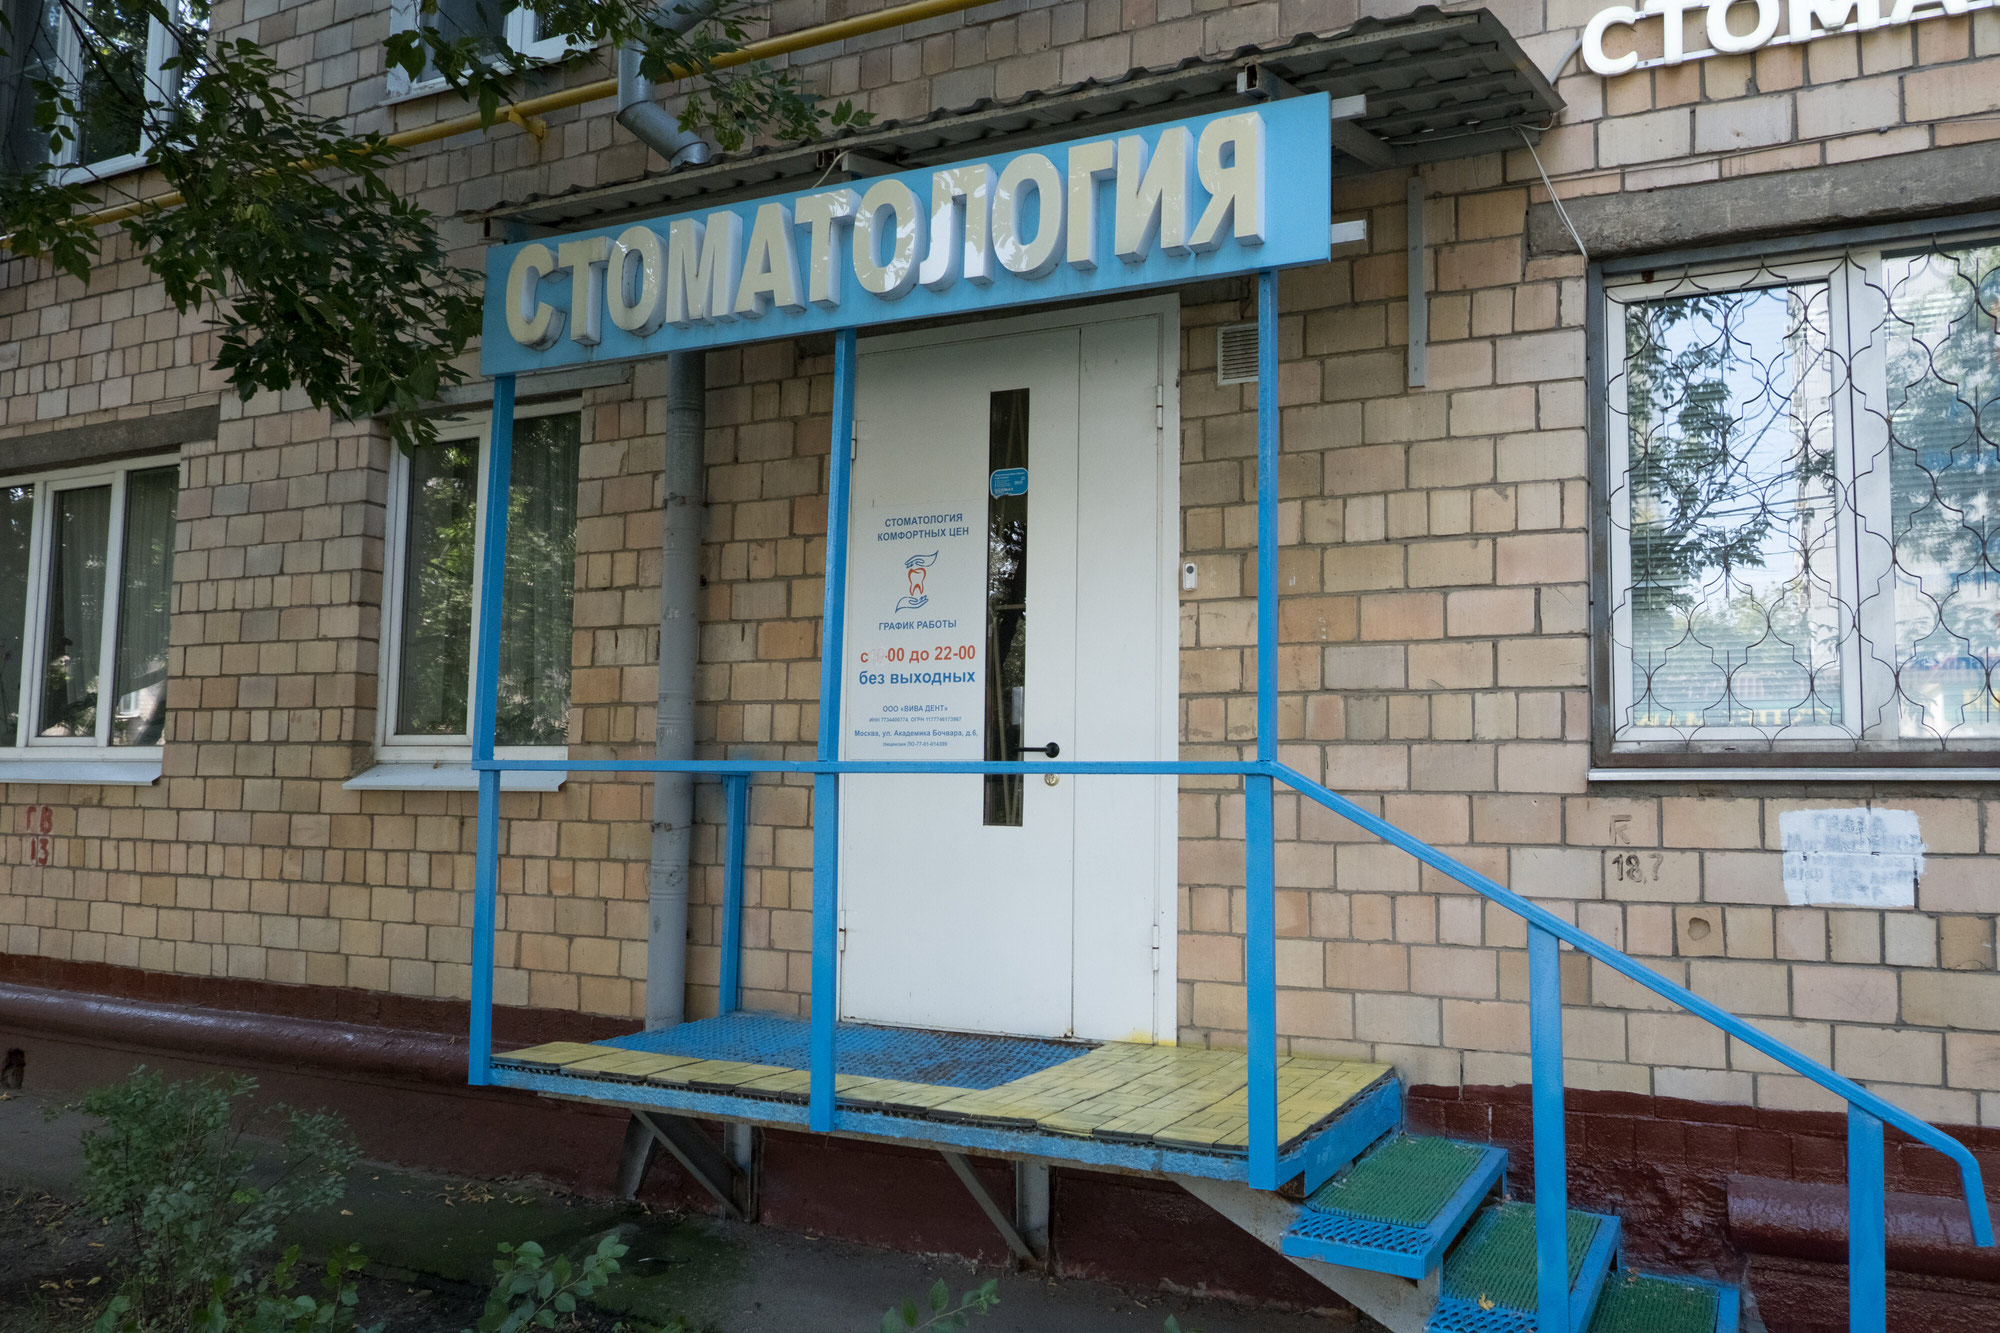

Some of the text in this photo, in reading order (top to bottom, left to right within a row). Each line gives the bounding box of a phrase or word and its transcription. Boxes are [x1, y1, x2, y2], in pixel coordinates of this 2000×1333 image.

[505, 110, 1266, 352] СТОМАТОЛОГИЯ
[885, 513, 963, 527] СТОМАТОЛОГИЯ
[877, 526, 969, 542] КОМФОРТНЫХ ЦЕН
[879, 620, 957, 630] ГРАФИК РАБОТЫ
[860, 652, 869, 663] с
[908, 650, 930, 664] до
[934, 645, 976, 660] 22-00
[859, 670, 976, 686] без выходных
[882, 704, 948, 713] ООО «ВИВА ДЕНТ»
[854, 730, 881, 738] Москва,
[893, 729, 931, 738] Академика
[932, 729, 964, 738] Бочвара,
[31, 837, 49, 866] 13
